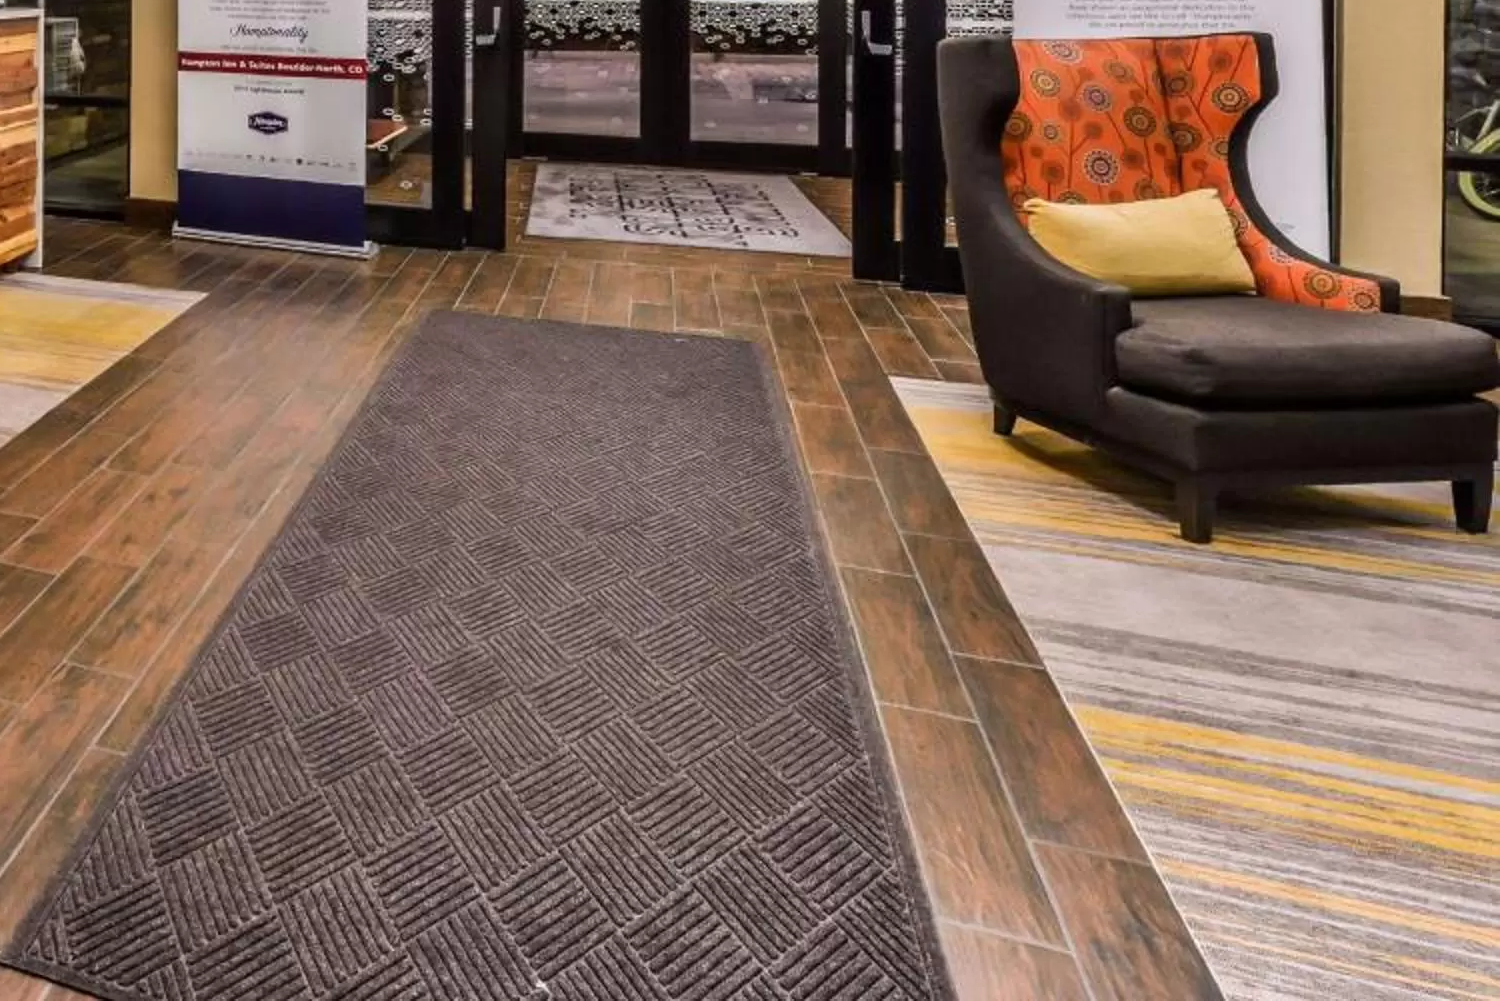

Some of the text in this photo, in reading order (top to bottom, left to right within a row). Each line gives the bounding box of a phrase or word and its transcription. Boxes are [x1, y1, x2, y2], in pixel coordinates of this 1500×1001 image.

[230, 23, 308, 43] Hamptonality
[181, 58, 220, 68] Hampton
[249, 60, 275, 70] Suites
[348, 65, 363, 74] CO
